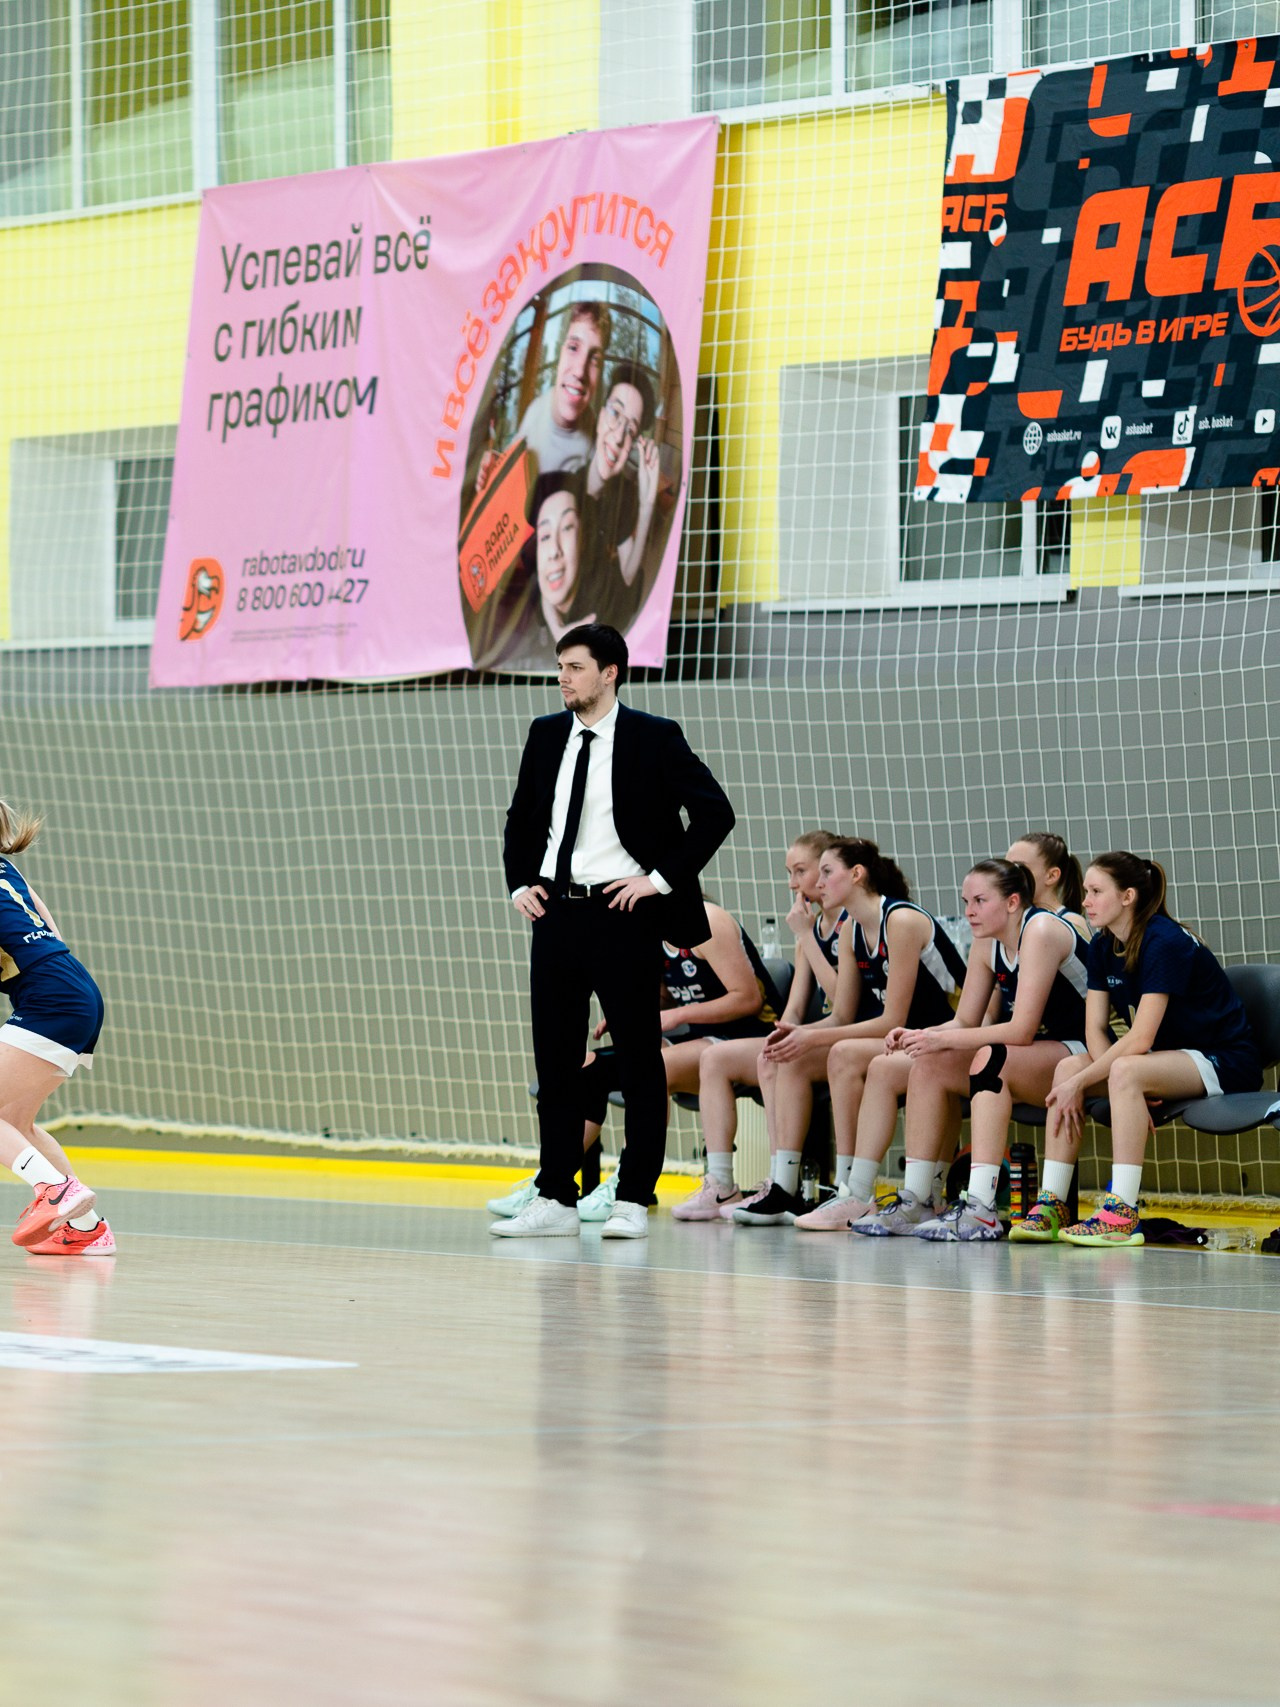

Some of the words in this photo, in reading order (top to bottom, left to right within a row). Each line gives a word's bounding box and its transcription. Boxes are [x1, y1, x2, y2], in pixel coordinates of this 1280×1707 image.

[221, 222, 363, 294] Успевай
[373, 215, 432, 275] всё
[482, 191, 676, 326] закрутится
[1063, 171, 1280, 307] АСБ
[213, 322, 233, 363] с
[240, 300, 363, 360] гибким
[1059, 322, 1133, 352] БУДЬ
[1135, 319, 1157, 345] В
[1158, 311, 1230, 344] ИГРЕ
[441, 309, 491, 432] всё
[206, 372, 379, 444] графиком
[431, 438, 456, 480] и
[236, 587, 249, 612] 8
[251, 584, 287, 611] 800
[289, 581, 325, 608] 600
